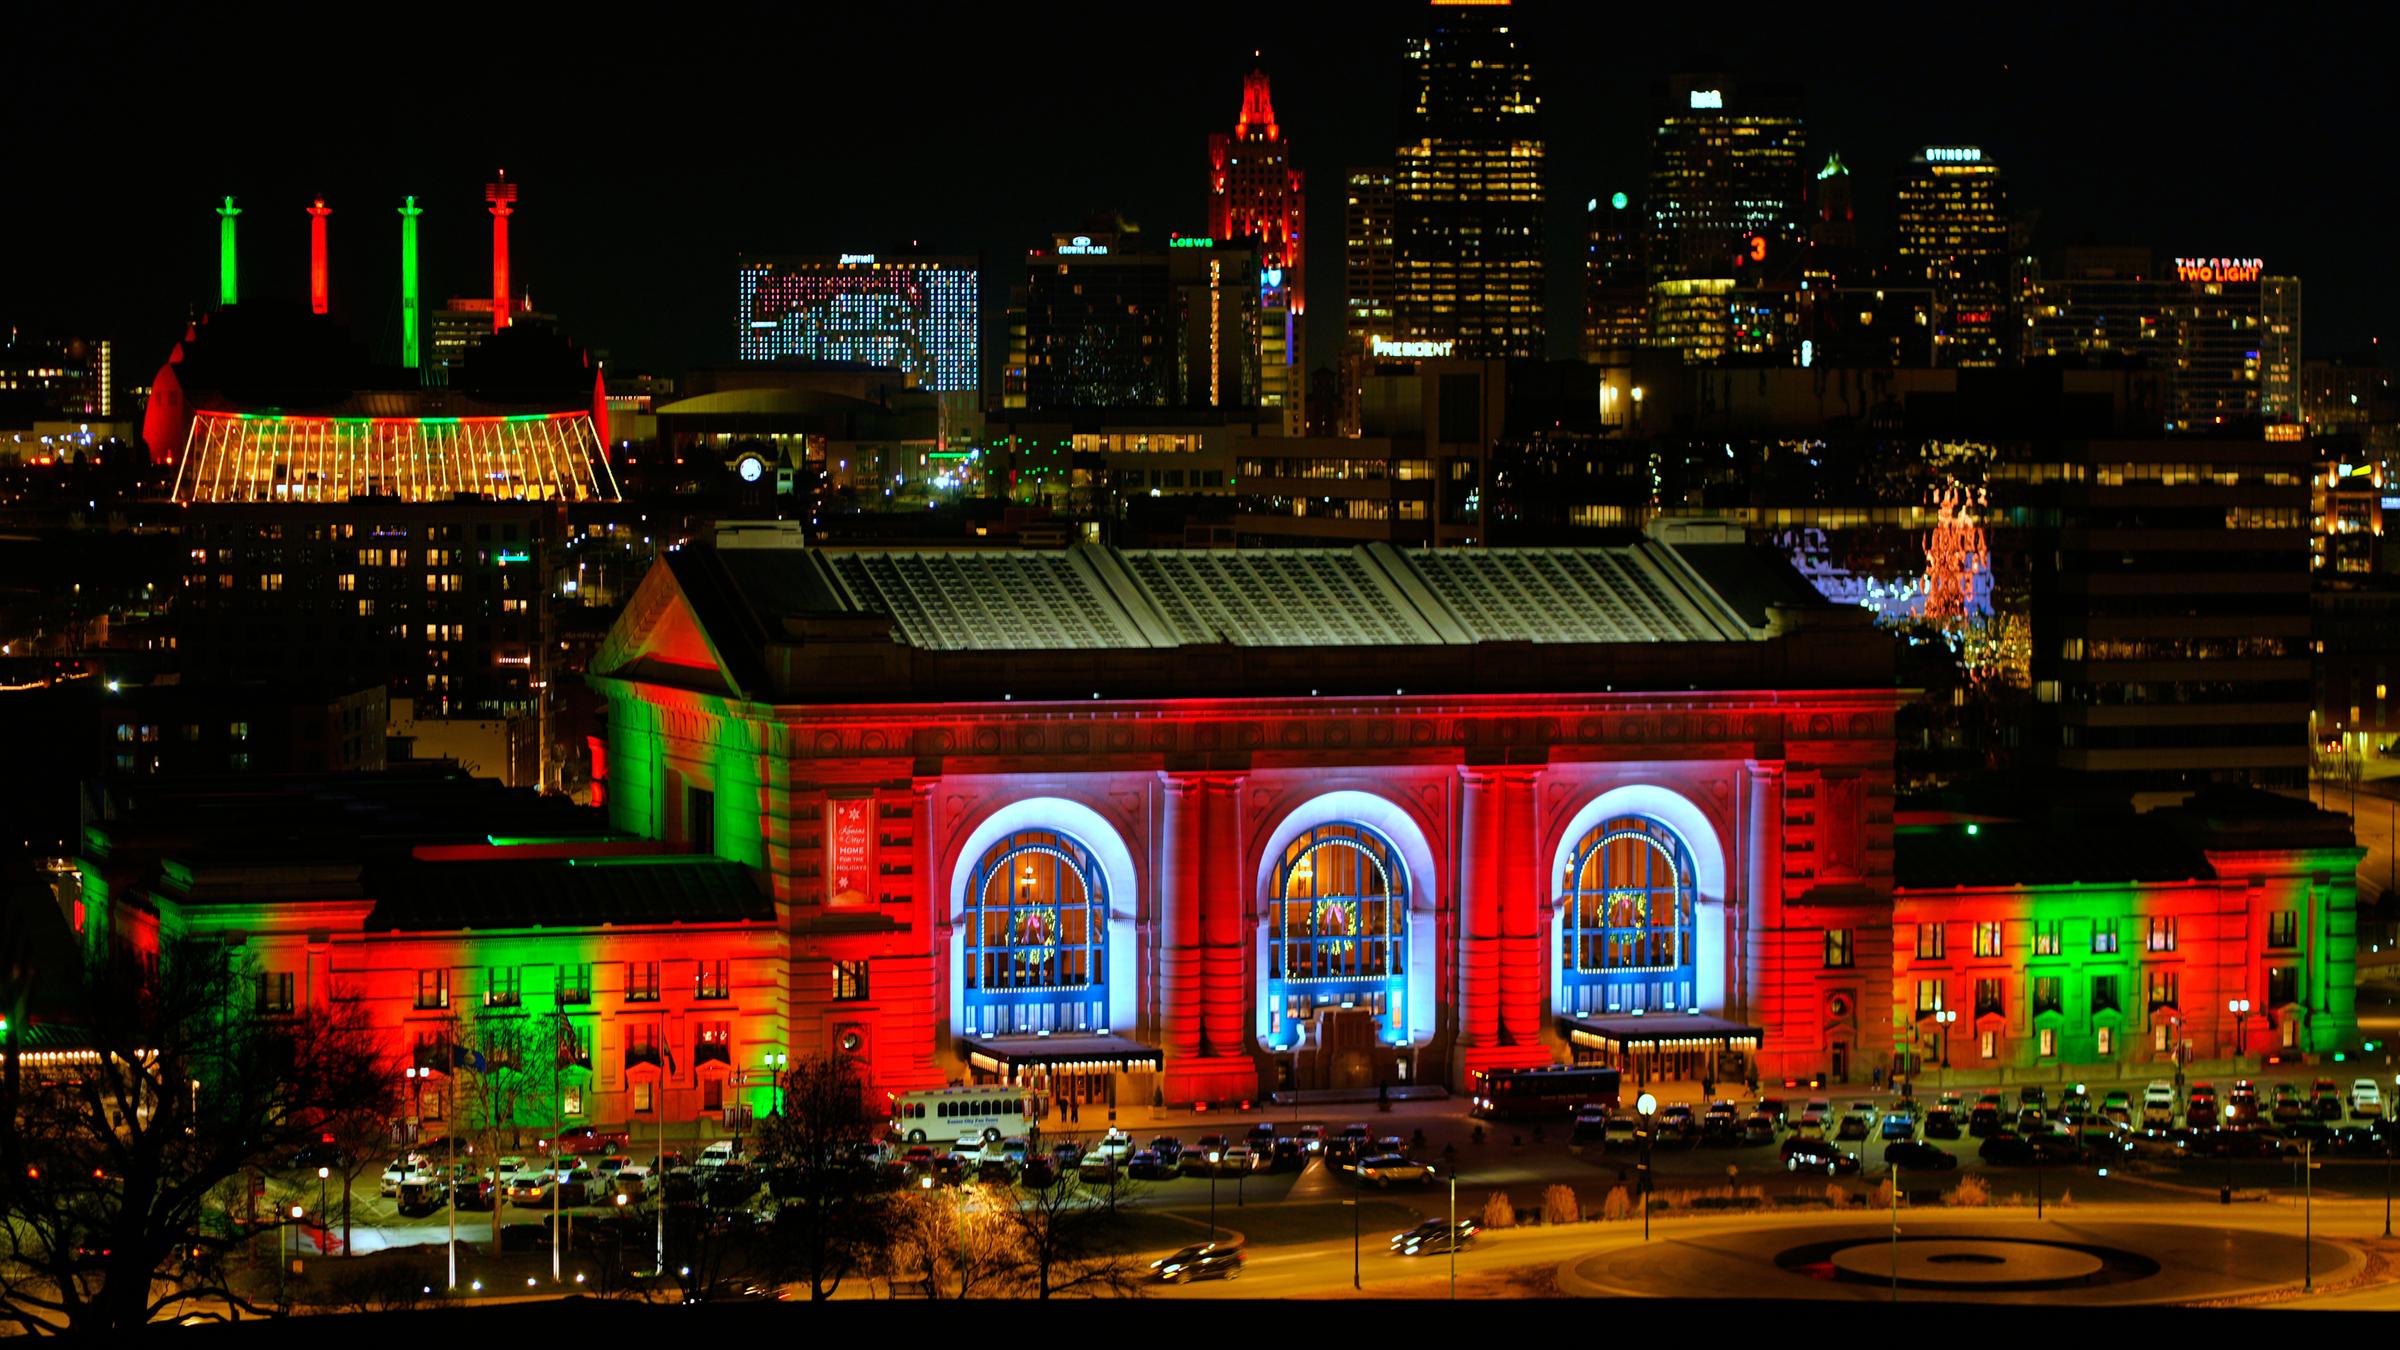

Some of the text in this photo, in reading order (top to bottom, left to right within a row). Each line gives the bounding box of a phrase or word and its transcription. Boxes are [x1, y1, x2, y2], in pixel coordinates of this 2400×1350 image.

[1926, 148, 1981, 161] STINSON
[1169, 237, 1213, 248] LOEWS
[1751, 236, 1766, 262] 3
[1086, 245, 1108, 255] PLAZA
[2177, 266, 2259, 282] TWO LIGHT
[1372, 339, 1453, 357] PRESIDENT
[839, 847, 864, 855] HOME
